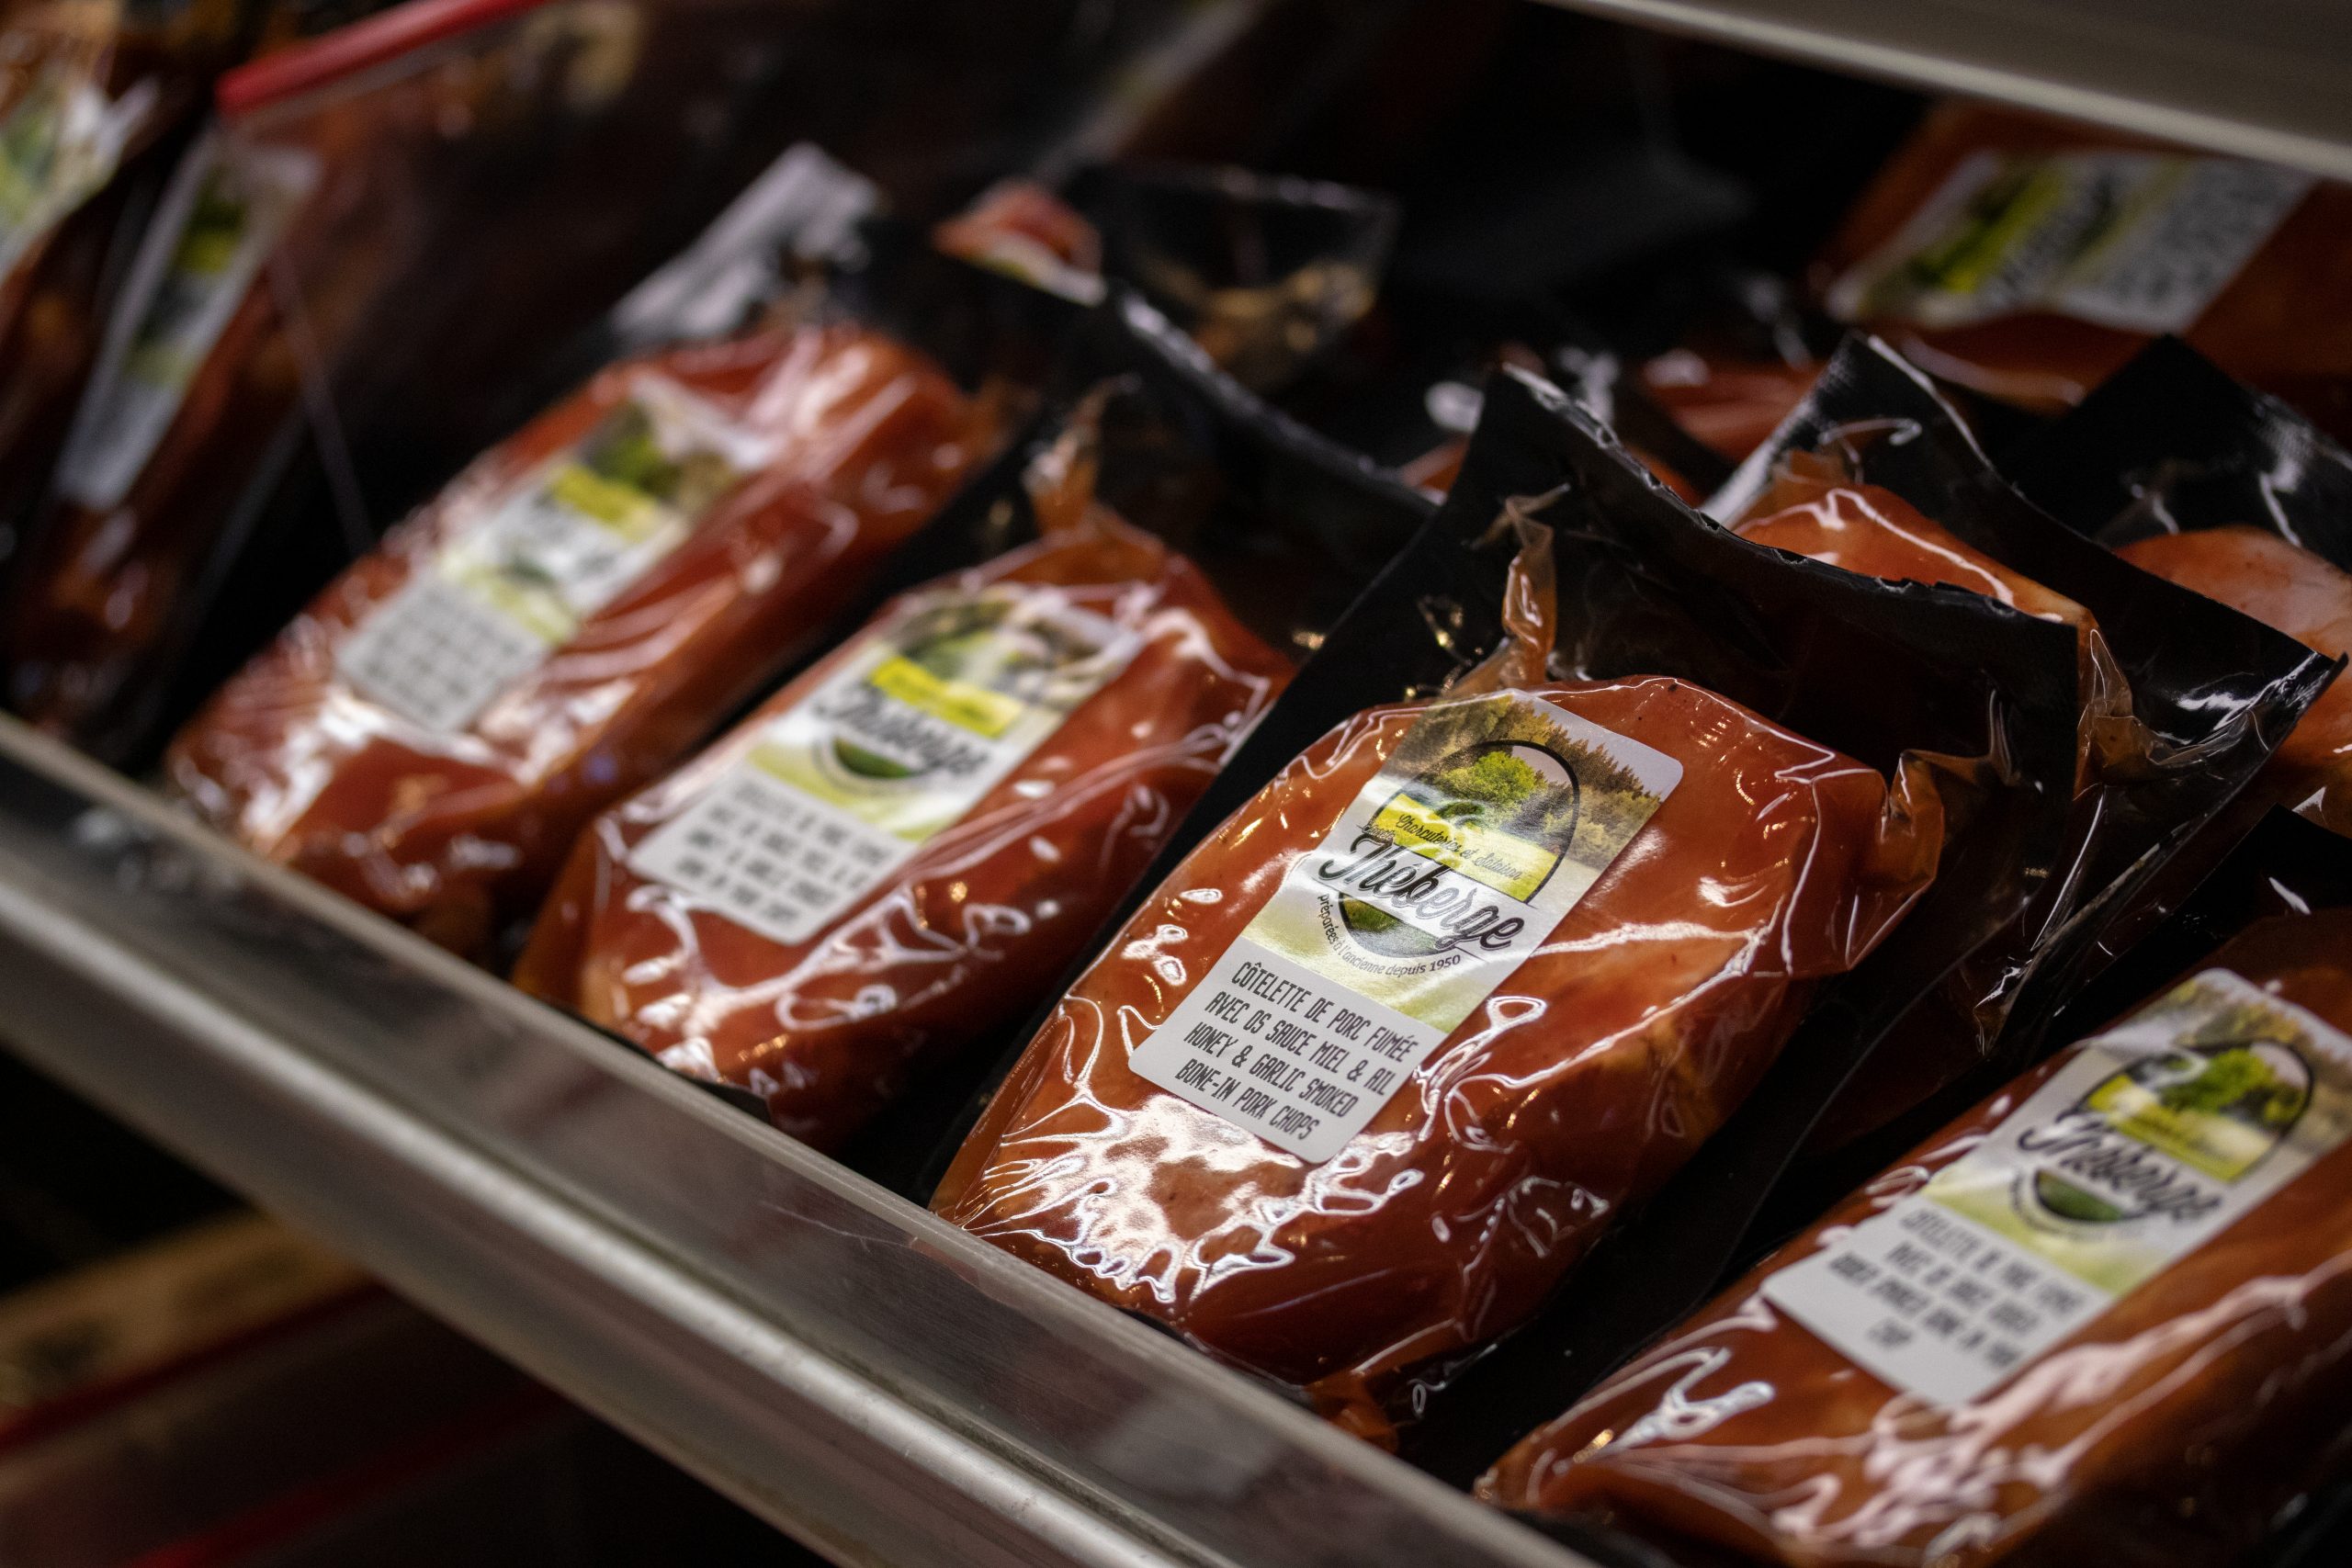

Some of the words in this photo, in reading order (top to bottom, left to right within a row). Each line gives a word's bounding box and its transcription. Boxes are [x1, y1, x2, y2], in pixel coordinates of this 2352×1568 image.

[1396, 814, 1463, 852] Charcuteries
[1460, 848, 1480, 860] et
[1317, 831, 1526, 953] Théberge
[1317, 893, 1339, 945] préparées
[1332, 940, 1343, 953] à
[1338, 943, 1387, 976] l'ancienne
[1385, 964, 1427, 978] depuis
[1429, 953, 1462, 973] 1950
[1204, 990, 1250, 1024] AVEC
[1243, 1009, 1272, 1034] OS
[1264, 1020, 1317, 1056] SAUCE
[1308, 1040, 1351, 1075] MIEL
[1346, 1059, 1370, 1083] &
[1363, 1067, 1396, 1096] AIL
[1231, 961, 1312, 1012] CÔTELETTE
[1304, 997, 1335, 1023] DE
[1326, 1008, 1372, 1042] PORC
[1363, 1026, 1419, 1063] FUMÉE
[1174, 1057, 1242, 1102] BONE-IN
[1232, 1087, 1278, 1120] PORK
[1269, 1105, 1320, 1141] CHOPS
[1183, 1021, 1238, 1058] HONEY
[1231, 1044, 1253, 1068] &
[1249, 1053, 1306, 1093] GARLIC
[1298, 1077, 1359, 1118] SMOKED
